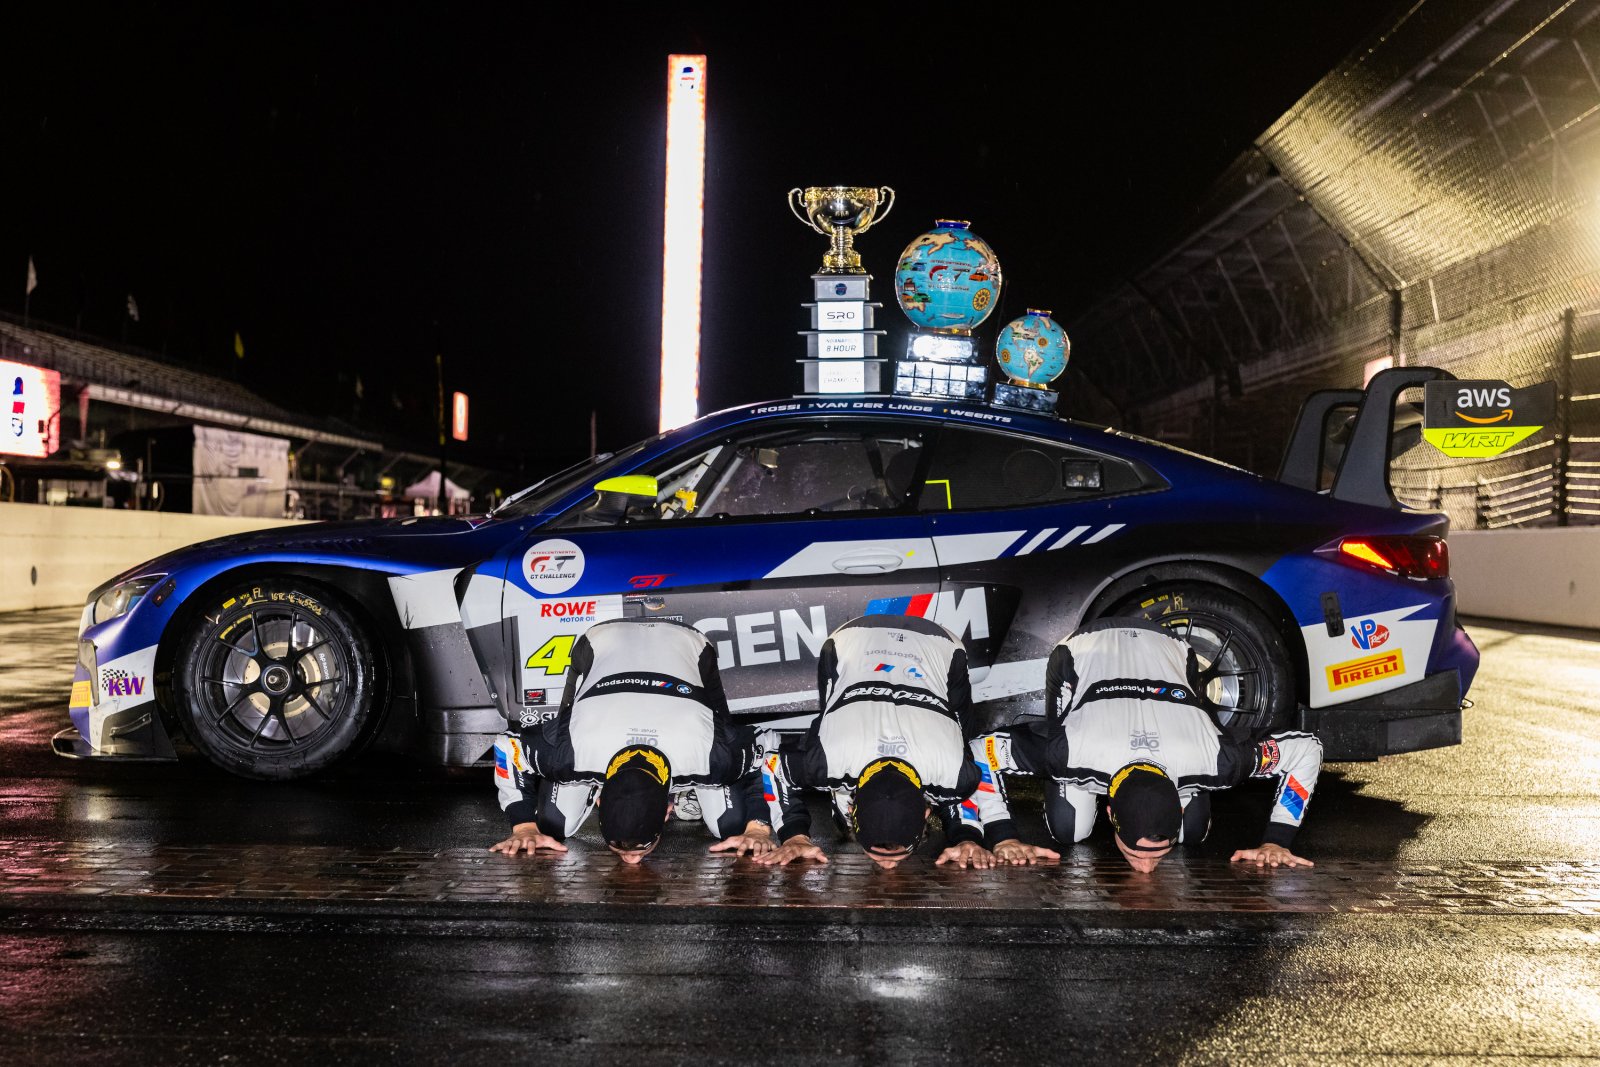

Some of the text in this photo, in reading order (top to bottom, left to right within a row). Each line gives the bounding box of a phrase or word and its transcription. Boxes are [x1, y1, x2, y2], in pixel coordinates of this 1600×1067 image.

[826, 311, 855, 320] SRO
[1456, 387, 1511, 408] aws
[757, 403, 801, 414] ROSSI
[816, 401, 933, 412] VAN DER LINDE
[950, 409, 1012, 423] WEERTS
[1441, 431, 1515, 449] WRT
[541, 601, 597, 618] ROWE
[1350, 619, 1377, 650] VP
[863, 648, 923, 664] Motorsport
[1332, 654, 1399, 687] PIRELLI
[108, 676, 145, 697] KW
[596, 677, 650, 690] Motorsport
[1095, 684, 1145, 694] Motorsport
[877, 743, 908, 756] OMP
[1130, 736, 1160, 749] OMP
